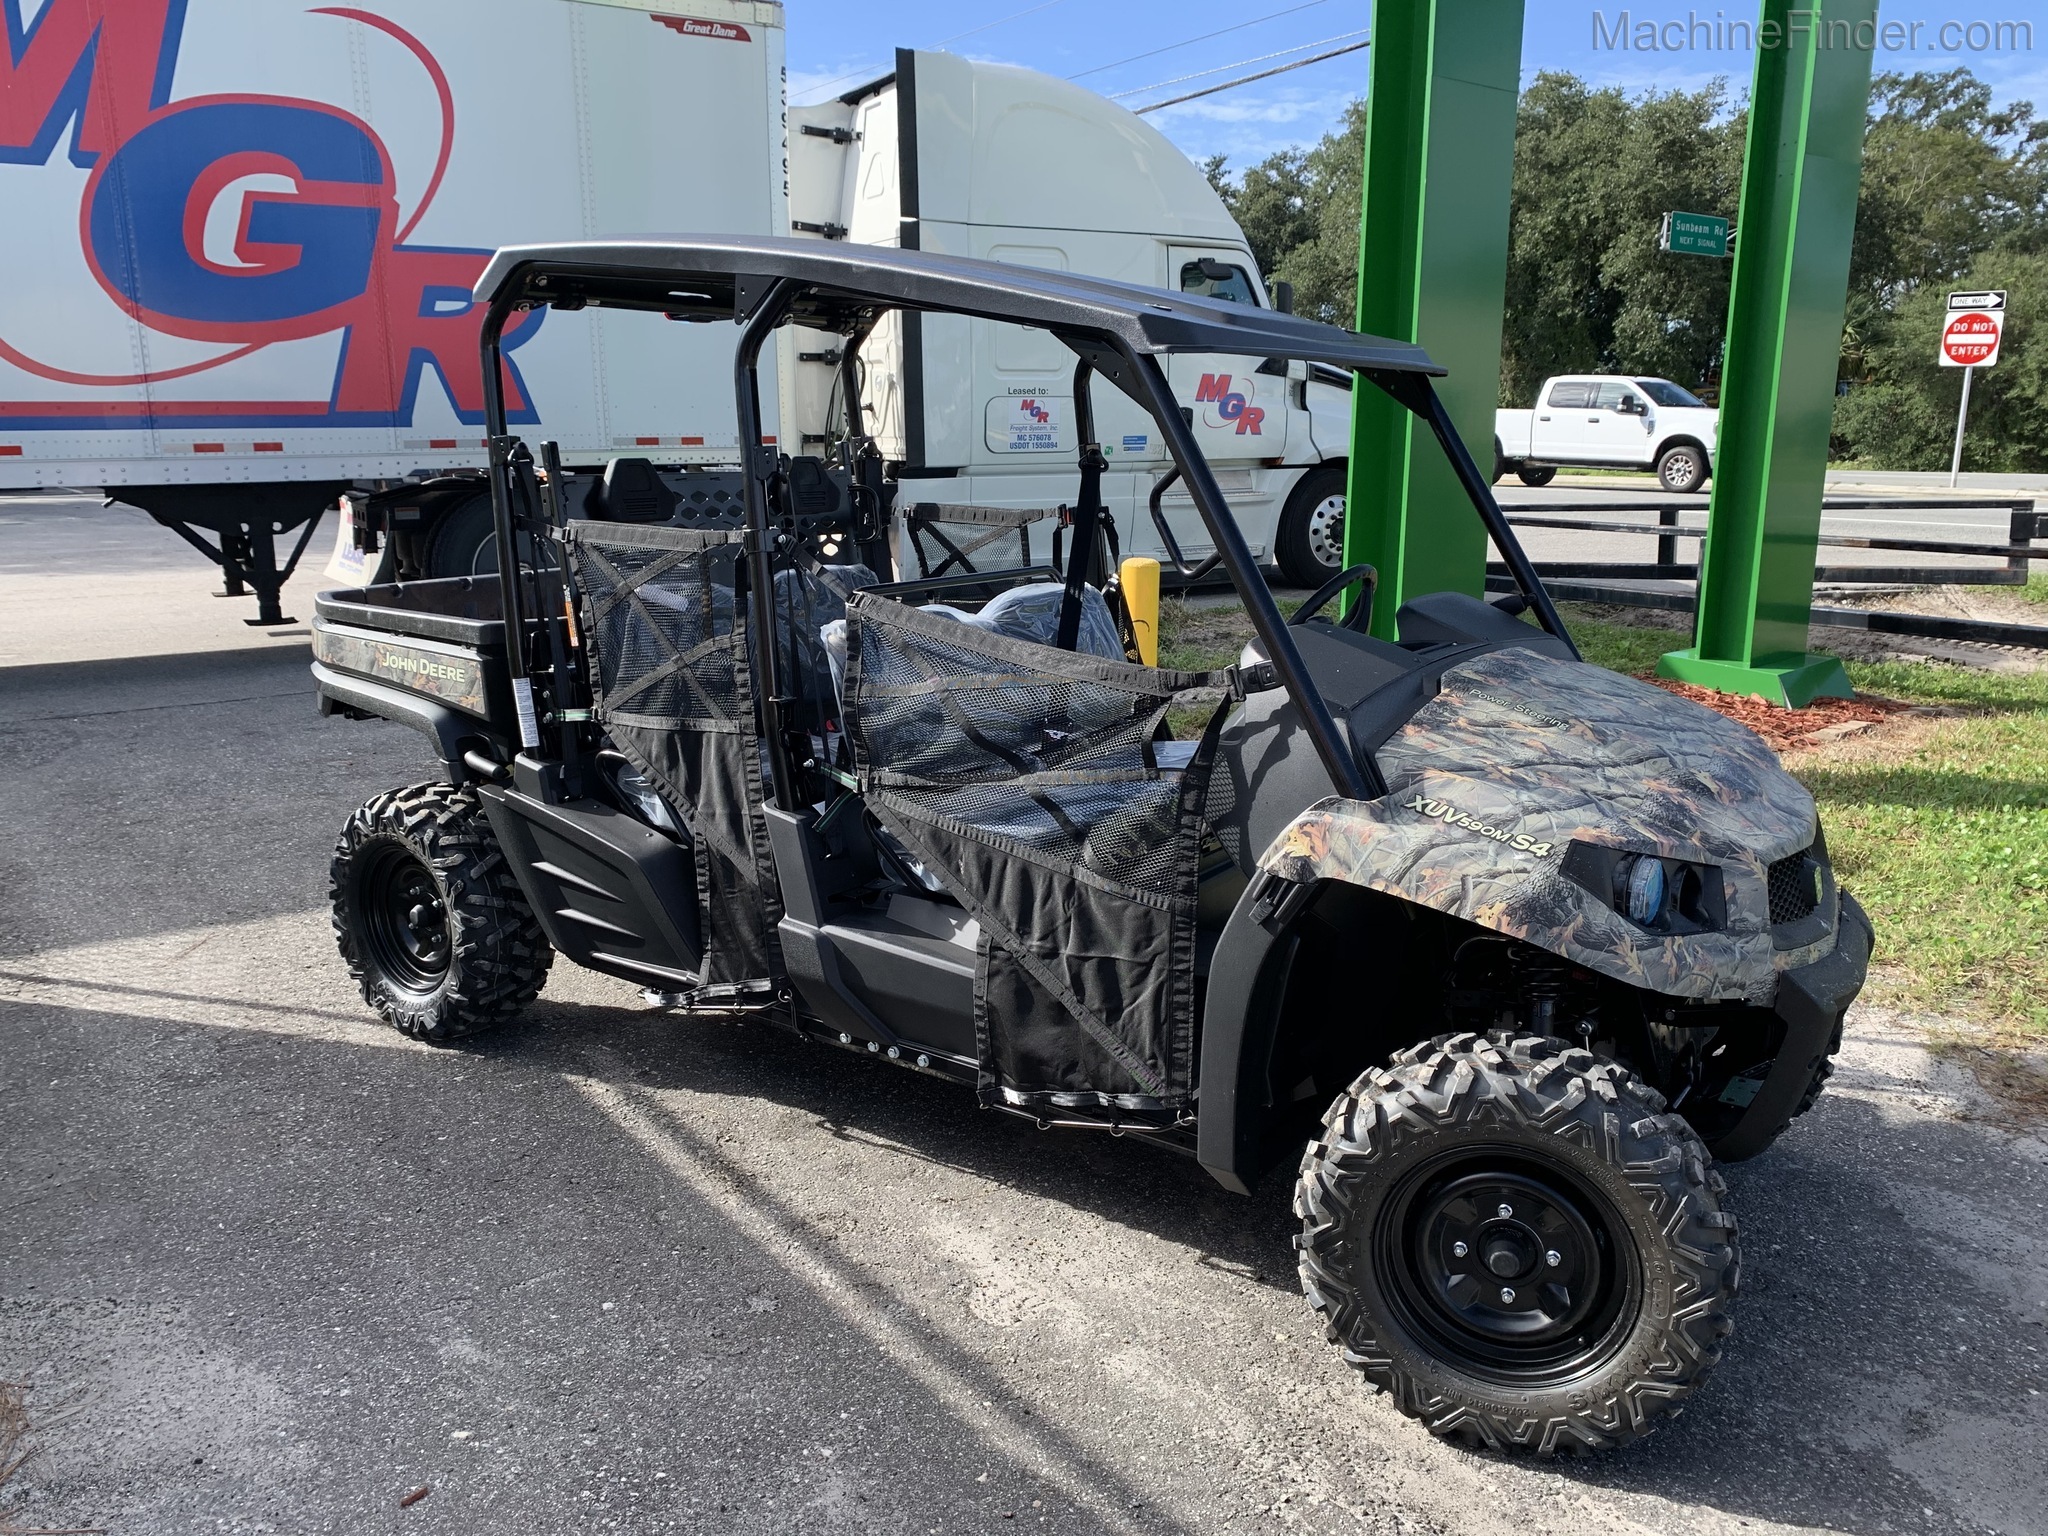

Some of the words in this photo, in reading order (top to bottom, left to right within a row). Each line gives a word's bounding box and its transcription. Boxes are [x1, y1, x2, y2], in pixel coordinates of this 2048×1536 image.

[683, 21, 711, 34] Great
[711, 24, 737, 38] Dane
[1676, 220, 1709, 234] Sunbeam
[1714, 225, 1724, 236] Rd
[1680, 236, 1694, 245] NEXT
[1698, 238, 1717, 248] SIGNAL
[1953, 322, 1969, 332] DO
[1972, 322, 1995, 332] NOT
[1951, 346, 1988, 355] ENTER
[1008, 387, 1036, 395] Leased
[1038, 387, 1049, 395] to:
[1020, 399, 1050, 423] MGR
[1195, 373, 1265, 435] MGR
[383, 652, 417, 672] JOHN
[420, 659, 465, 682] DEERE
[1469, 688, 1511, 707] Power
[1514, 704, 1570, 731] Steering
[1404, 794, 1513, 843] XUV590M
[1509, 833, 1554, 858] S4
